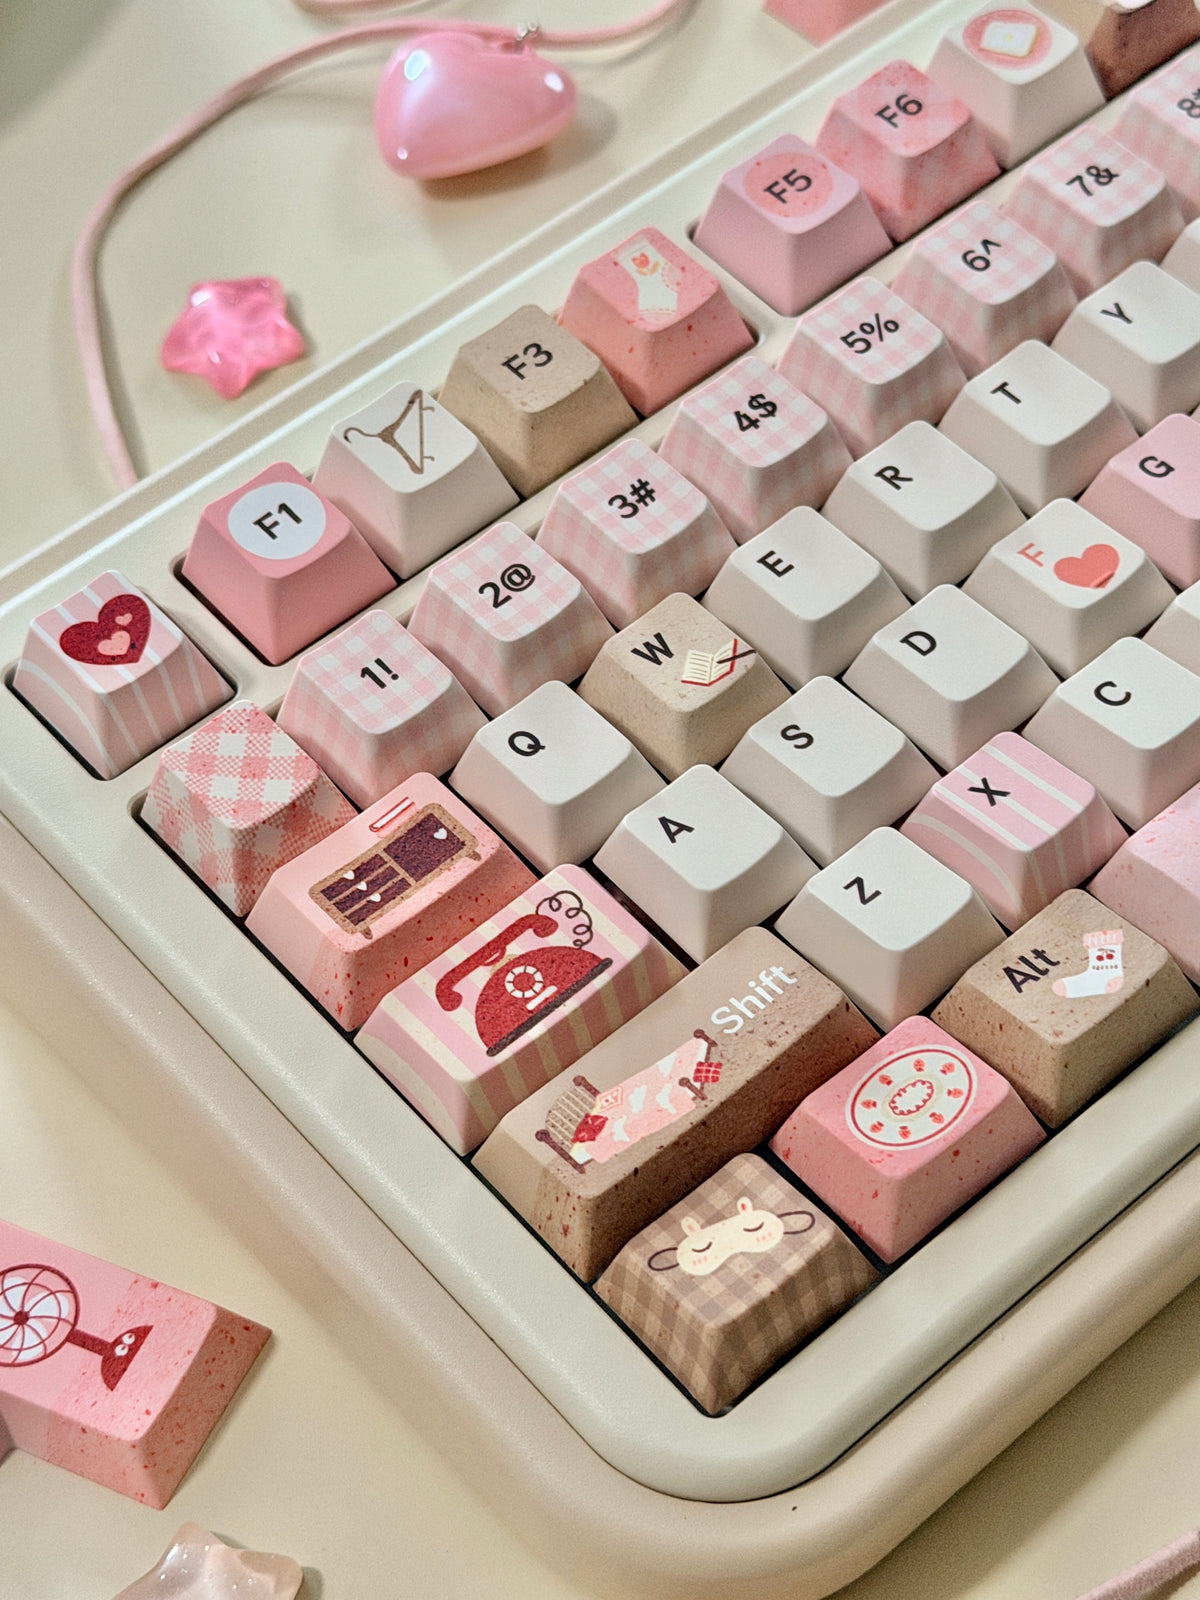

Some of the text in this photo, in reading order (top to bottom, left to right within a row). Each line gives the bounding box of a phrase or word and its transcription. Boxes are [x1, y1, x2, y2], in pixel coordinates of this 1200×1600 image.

[875, 93, 923, 128] F6
[763, 168, 812, 204] F5
[1066, 165, 1119, 196] 7&
[961, 238, 1001, 272] 6^
[1101, 302, 1132, 324] Y
[839, 313, 900, 354] 5%
[501, 342, 554, 381] F3
[991, 381, 1022, 404] T
[733, 393, 778, 432] 4$
[874, 465, 913, 491] R
[1138, 455, 1175, 478] G
[607, 478, 656, 519] 3#
[252, 502, 302, 540] F1
[756, 550, 795, 578] E
[1018, 542, 1043, 568] F
[478, 563, 536, 609] 2@
[630, 631, 675, 666] W
[899, 630, 937, 657] D
[360, 657, 400, 689] 1!
[1093, 680, 1132, 707] C
[507, 730, 546, 757] Q
[780, 724, 814, 750] S
[967, 777, 1011, 807] X
[658, 816, 695, 844] A
[843, 876, 882, 906] Z
[1002, 948, 1061, 994] Alt
[710, 965, 798, 1034] Shift
